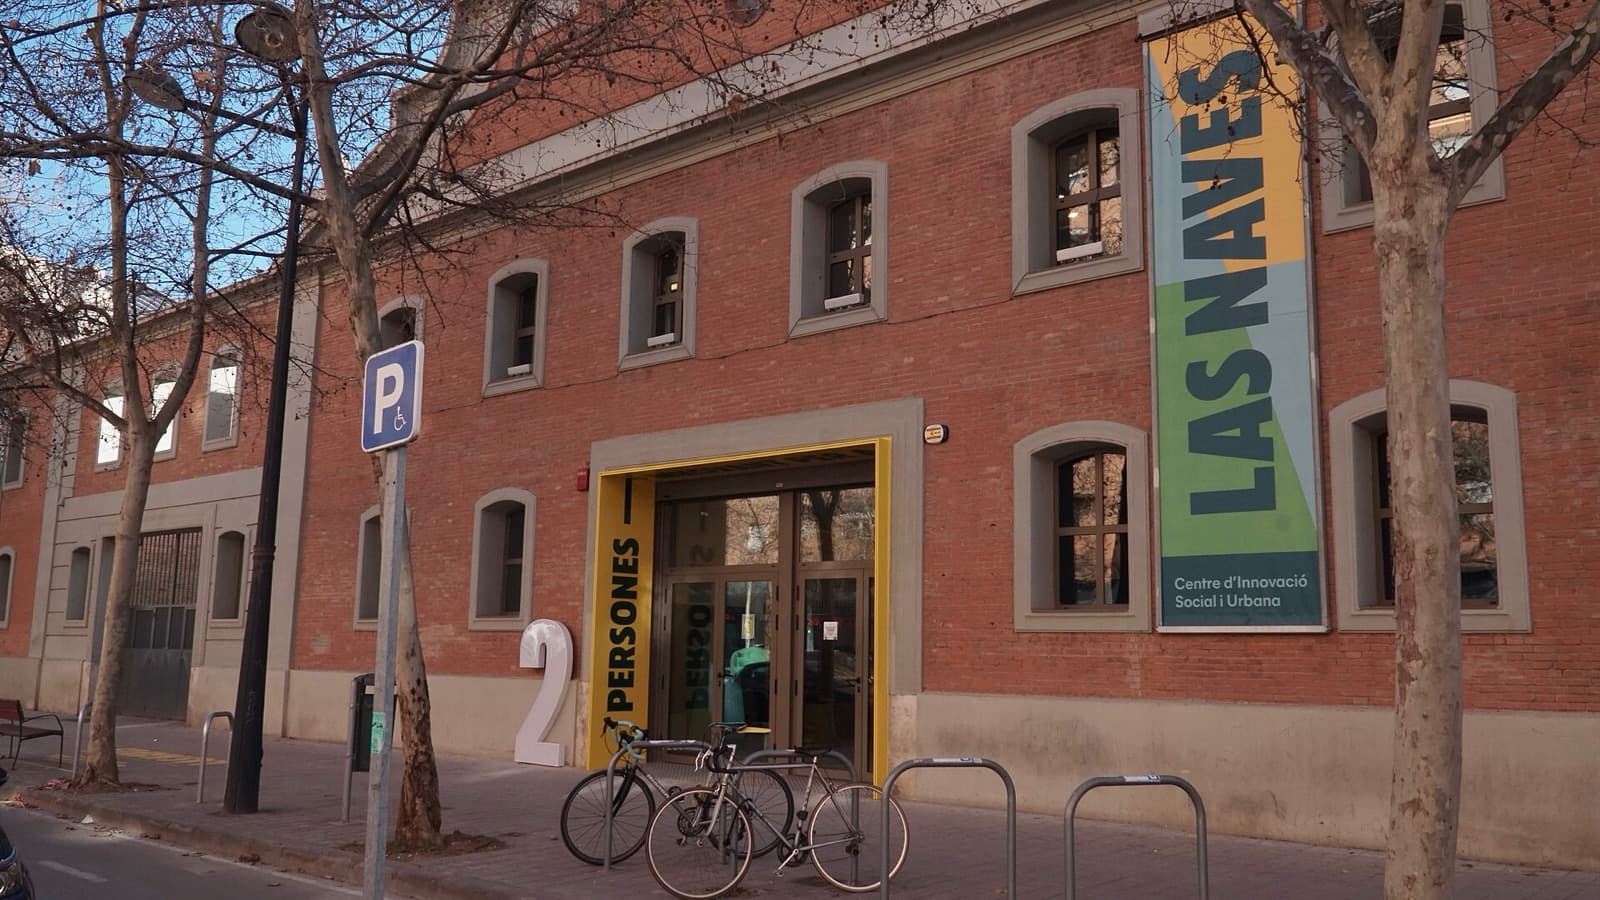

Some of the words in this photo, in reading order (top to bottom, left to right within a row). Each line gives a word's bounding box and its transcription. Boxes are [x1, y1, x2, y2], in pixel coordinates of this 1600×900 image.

[1179, 50, 1269, 336] NAVES
[374, 363, 404, 435] P
[1185, 349, 1276, 515] LAS
[607, 537, 639, 712] PERSONES
[1174, 577, 1221, 590] Centre
[1175, 594, 1217, 608] Social
[1219, 594, 1224, 607] i
[1226, 594, 1281, 607] Urbana
[514, 618, 573, 767] 2
